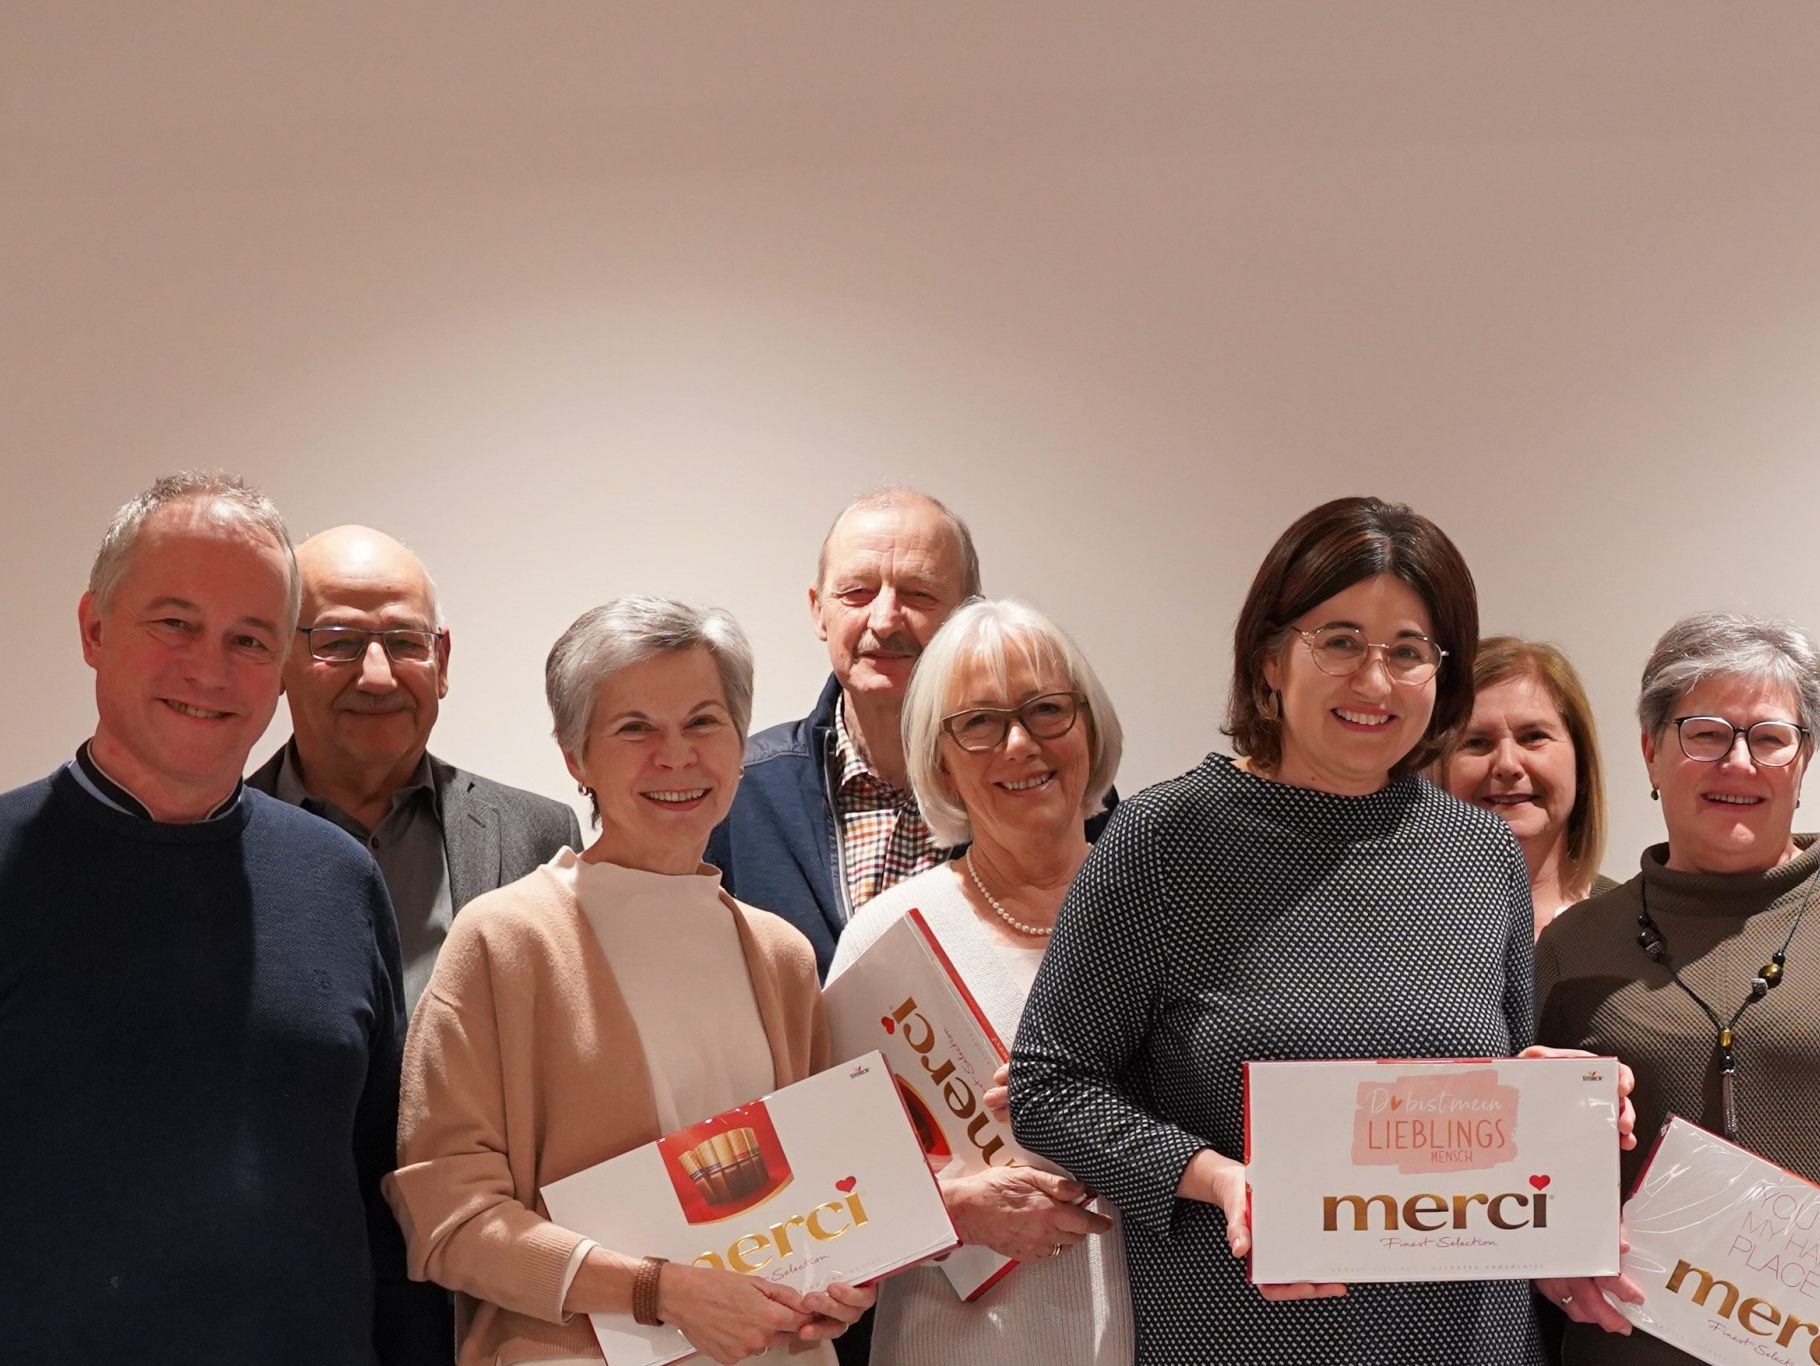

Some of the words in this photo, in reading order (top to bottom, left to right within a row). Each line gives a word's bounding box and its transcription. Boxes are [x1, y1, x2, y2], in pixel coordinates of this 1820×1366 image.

[1368, 1118, 1505, 1150] LIEBLINGS
[1431, 1150, 1473, 1164] MENSCH
[1322, 1174, 1551, 1232] merci
[1760, 1184, 1819, 1231] YOU
[1741, 1211, 1785, 1242] MY
[1379, 1236, 1434, 1250] Finest
[1435, 1235, 1499, 1249] Selection
